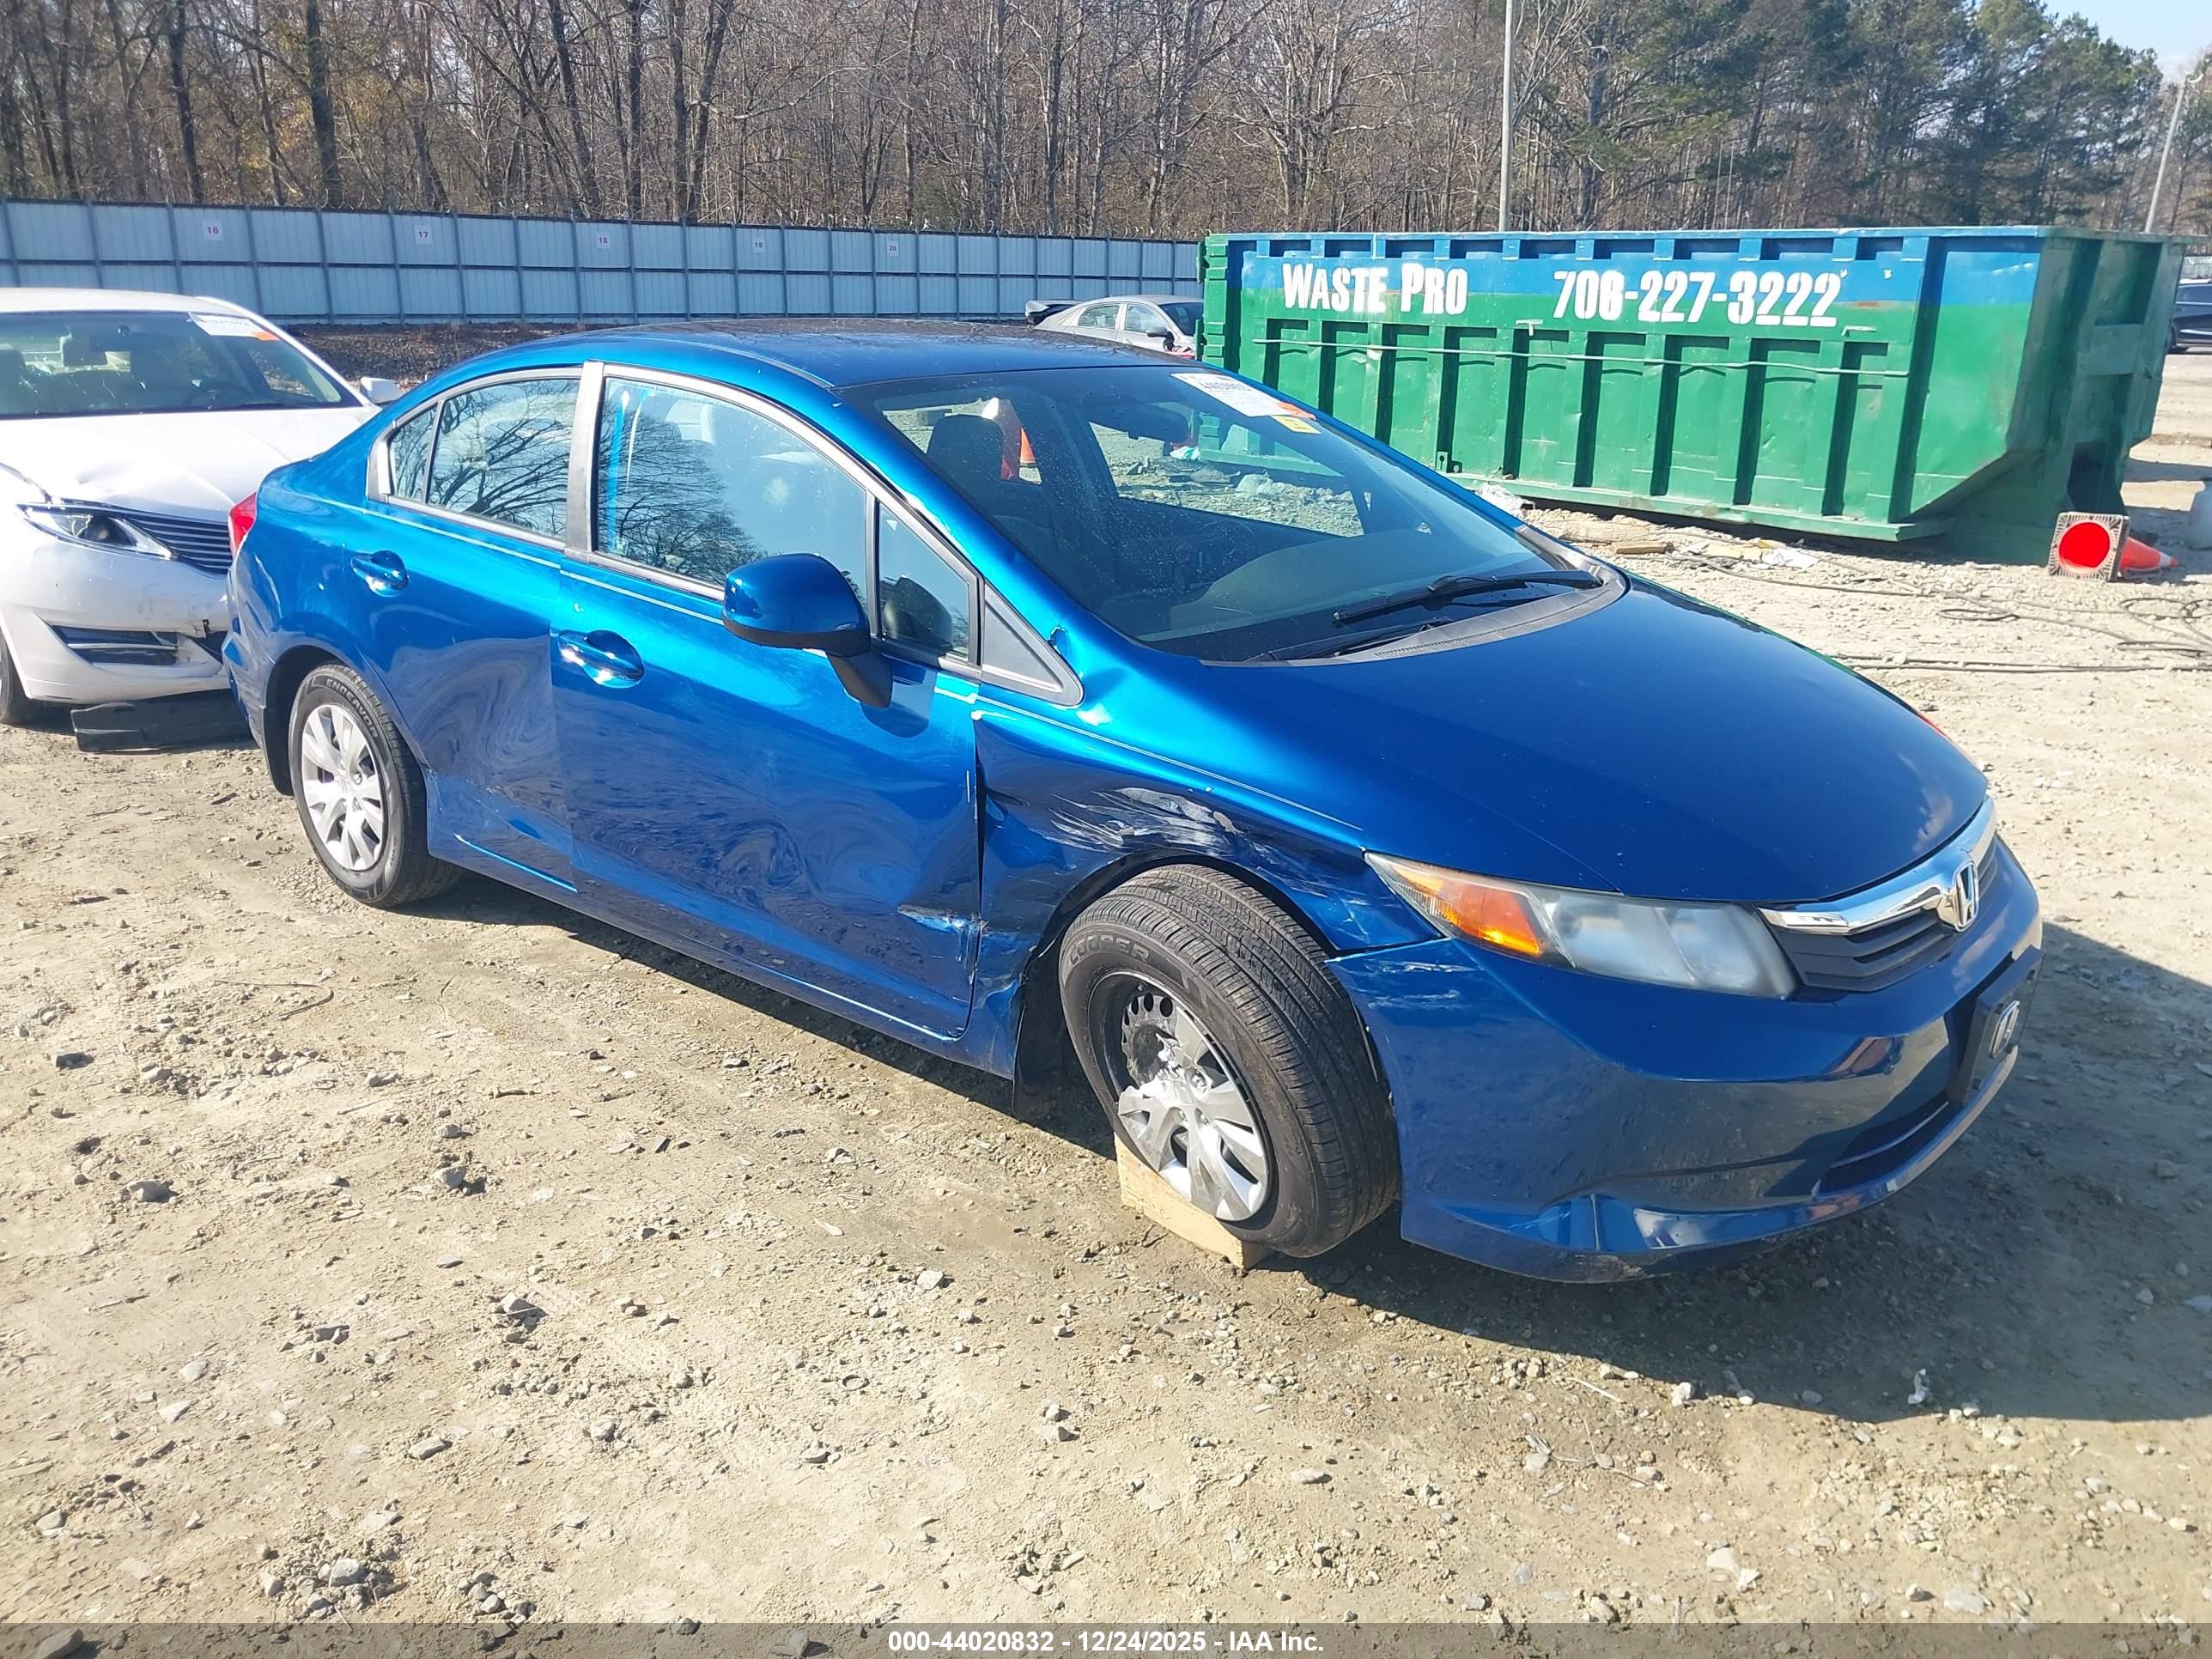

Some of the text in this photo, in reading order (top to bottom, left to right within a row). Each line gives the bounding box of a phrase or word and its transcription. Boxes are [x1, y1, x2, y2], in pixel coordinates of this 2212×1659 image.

[1282, 262, 1468, 315] WASTE PRO
[325, 678, 379, 738] ENDEAVOR
[1069, 933, 1150, 965] COOPER
